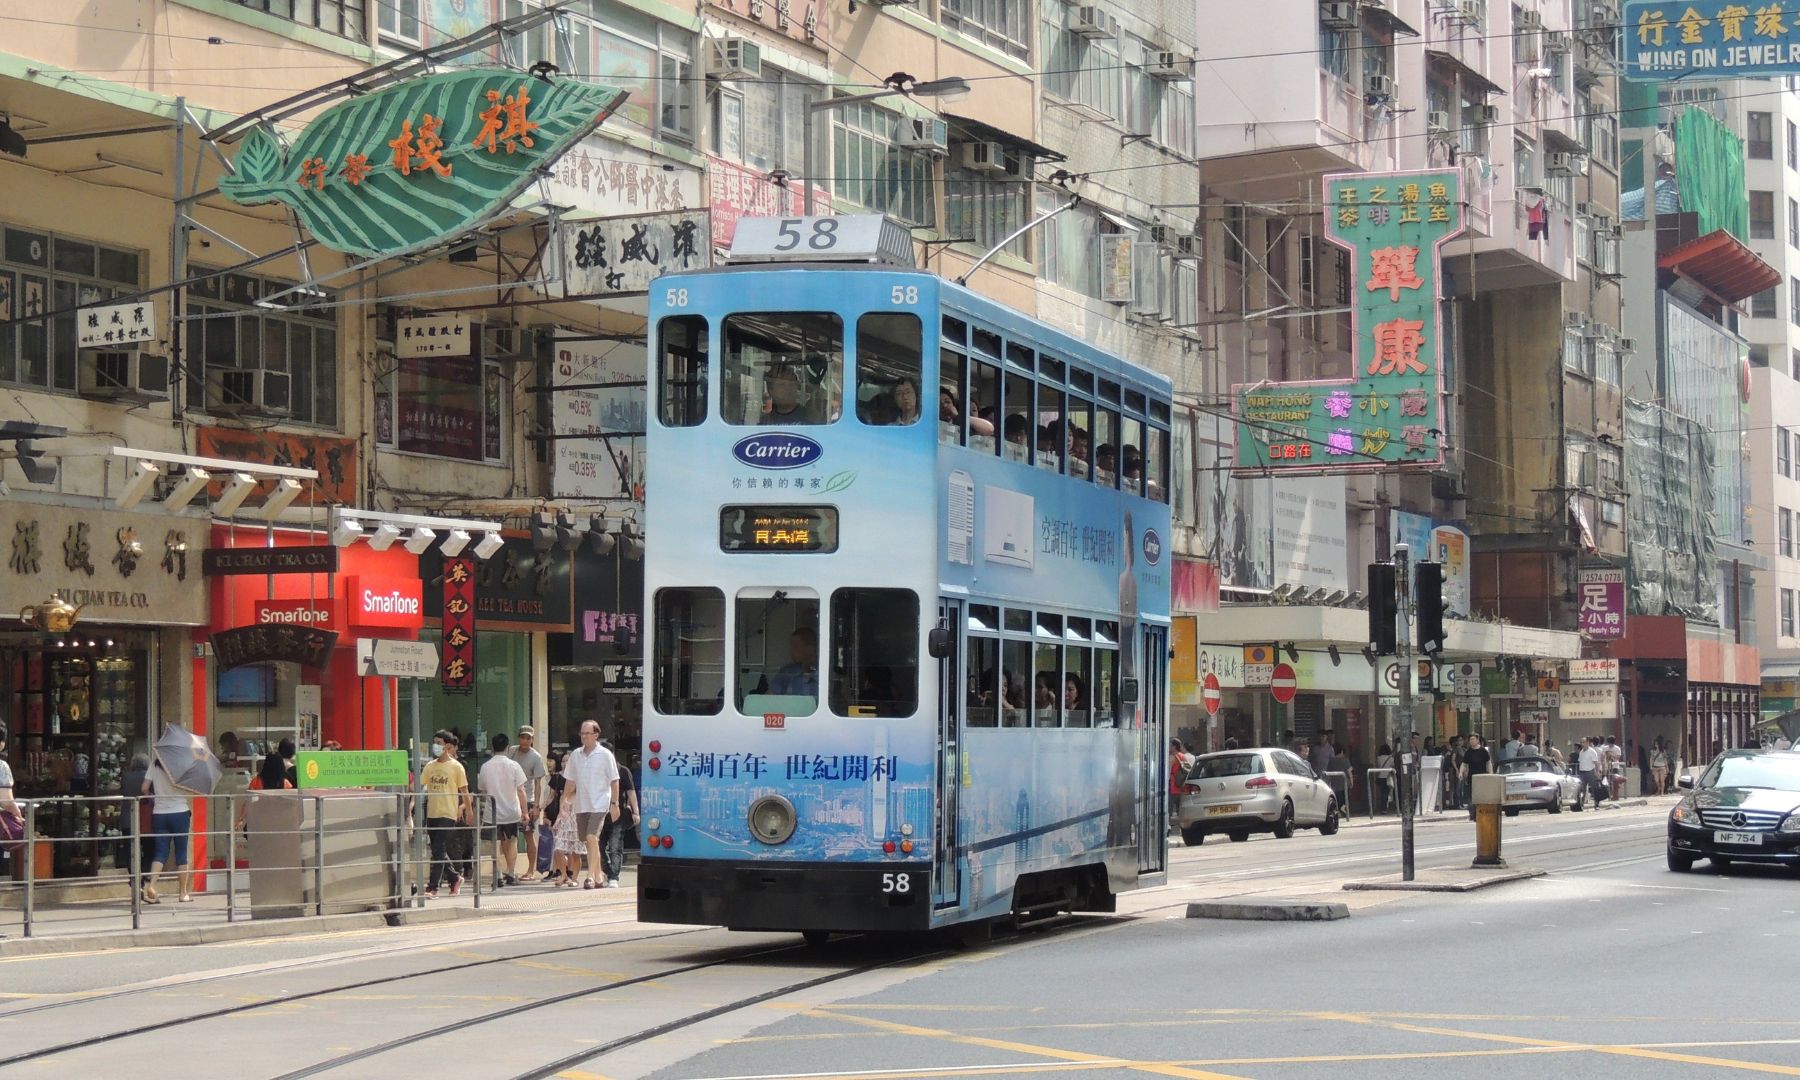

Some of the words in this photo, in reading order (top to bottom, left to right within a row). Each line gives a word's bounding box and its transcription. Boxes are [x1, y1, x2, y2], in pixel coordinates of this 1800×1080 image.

[1637, 3, 1800, 46] 珠寶金行
[1638, 51, 1685, 71] WING
[1692, 49, 1717, 68] ON
[774, 218, 839, 250] 58
[666, 288, 689, 307] 58
[891, 285, 919, 304] 58
[745, 442, 810, 458] Carrier
[732, 477, 821, 489] 你信賴的專家
[73, 589, 105, 607] CHAN
[108, 591, 129, 608] TEA
[364, 590, 419, 615] SmarTone
[1581, 585, 1608, 611] 足
[261, 608, 329, 624] SmarTone
[445, 563, 470, 679] 英記茶莊
[766, 716, 783, 726] 020
[667, 752, 768, 780] 空調百年
[784, 754, 898, 782] 世紀開利
[1720, 833, 1733, 841] NF
[1737, 834, 1756, 843] 754
[882, 874, 910, 893] 58
